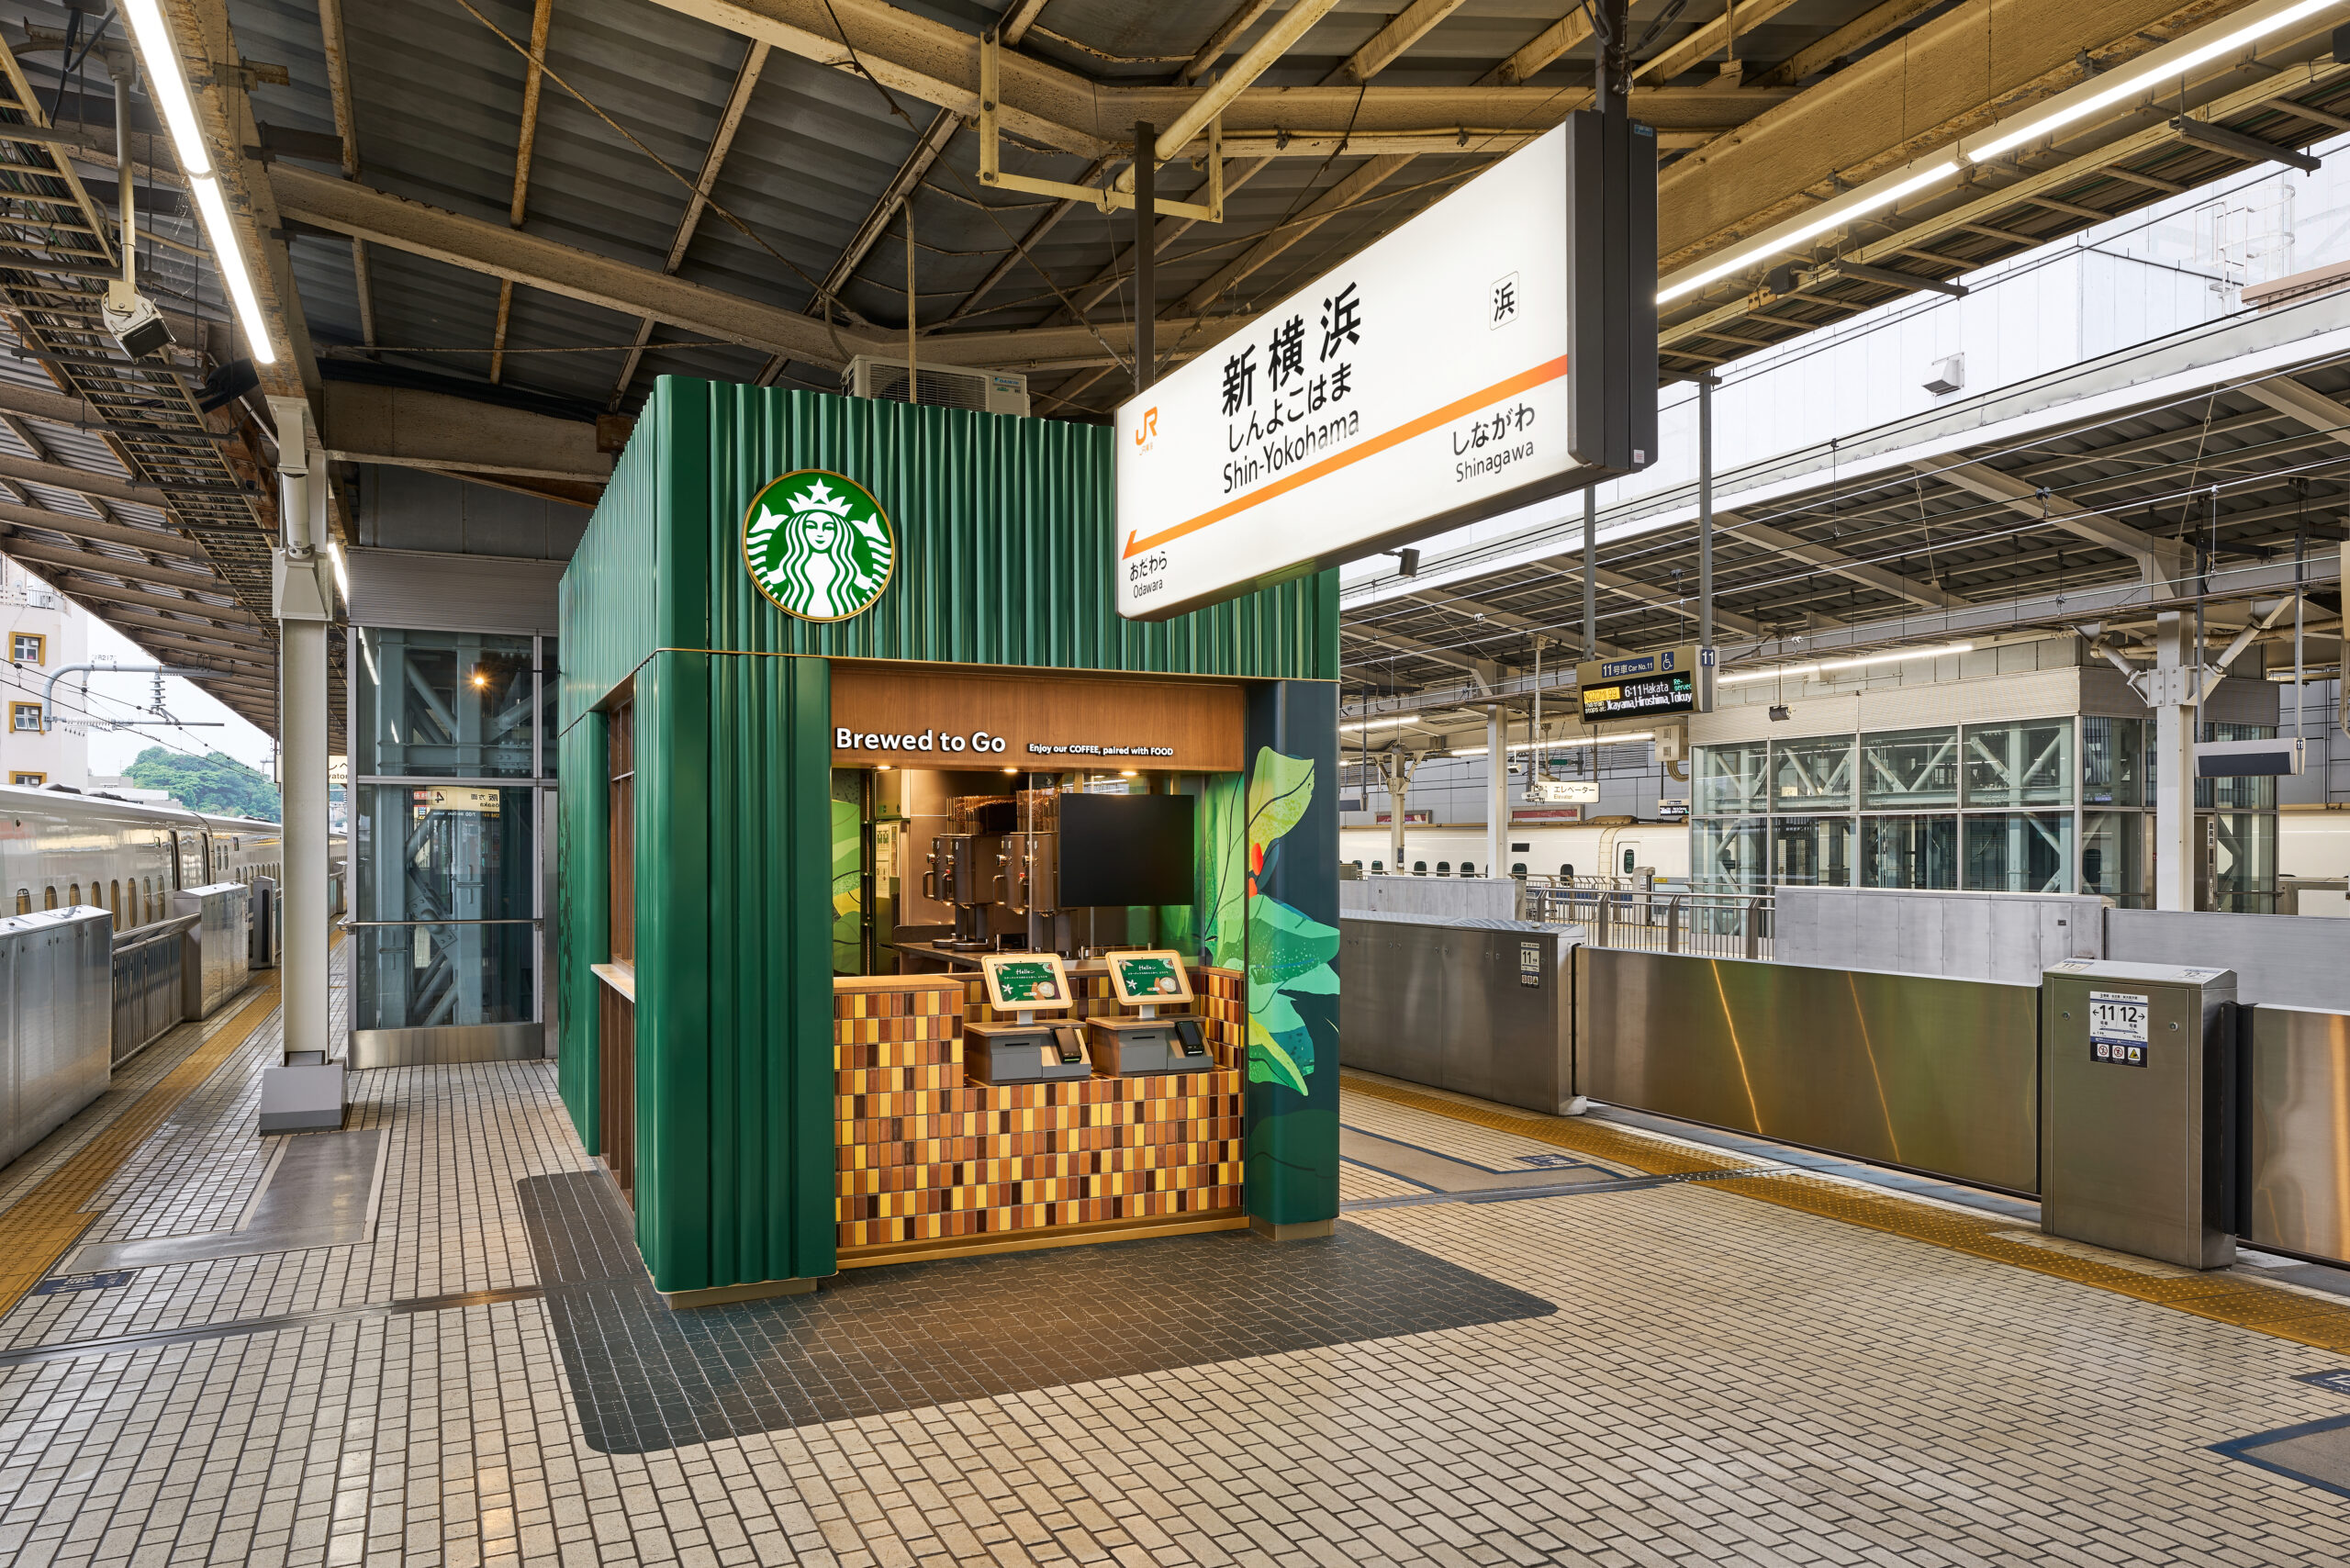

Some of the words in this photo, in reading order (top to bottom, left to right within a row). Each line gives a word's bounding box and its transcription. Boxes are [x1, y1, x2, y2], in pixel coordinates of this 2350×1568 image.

[1494, 281, 1515, 322] 浜
[1222, 281, 1361, 418] 新横浜
[1229, 362, 1352, 454] しんよこはま
[1135, 406, 1158, 446] JR
[1452, 402, 1536, 457] しながわ
[1223, 409, 1360, 494] Shin-Yokohama
[1456, 441, 1534, 483] Shinagawa
[1129, 550, 1168, 582] おだわら
[1133, 578, 1163, 599] Odawara
[1702, 651, 1715, 666] 11
[1603, 664, 1628, 677] 11号車
[1638, 662, 1653, 671] No.11
[1624, 684, 1642, 698] 6:11
[1642, 680, 1669, 695] Hakata
[1584, 706, 1599, 714] stops
[836, 727, 933, 751] Brewed
[939, 732, 966, 752] to
[971, 731, 1006, 753] Go
[1028, 744, 1052, 754] Enjoy
[1069, 745, 1102, 755] COFFEE,
[1102, 745, 1129, 756] paired
[1130, 746, 1149, 756] with
[1150, 747, 1174, 756] FOOD
[2296, 740, 2303, 749] 11
[1553, 786, 1595, 794] エレベーター
[1522, 950, 1531, 964] 11
[2099, 1004, 2115, 1021] 11
[2120, 1006, 2138, 1023] 12
